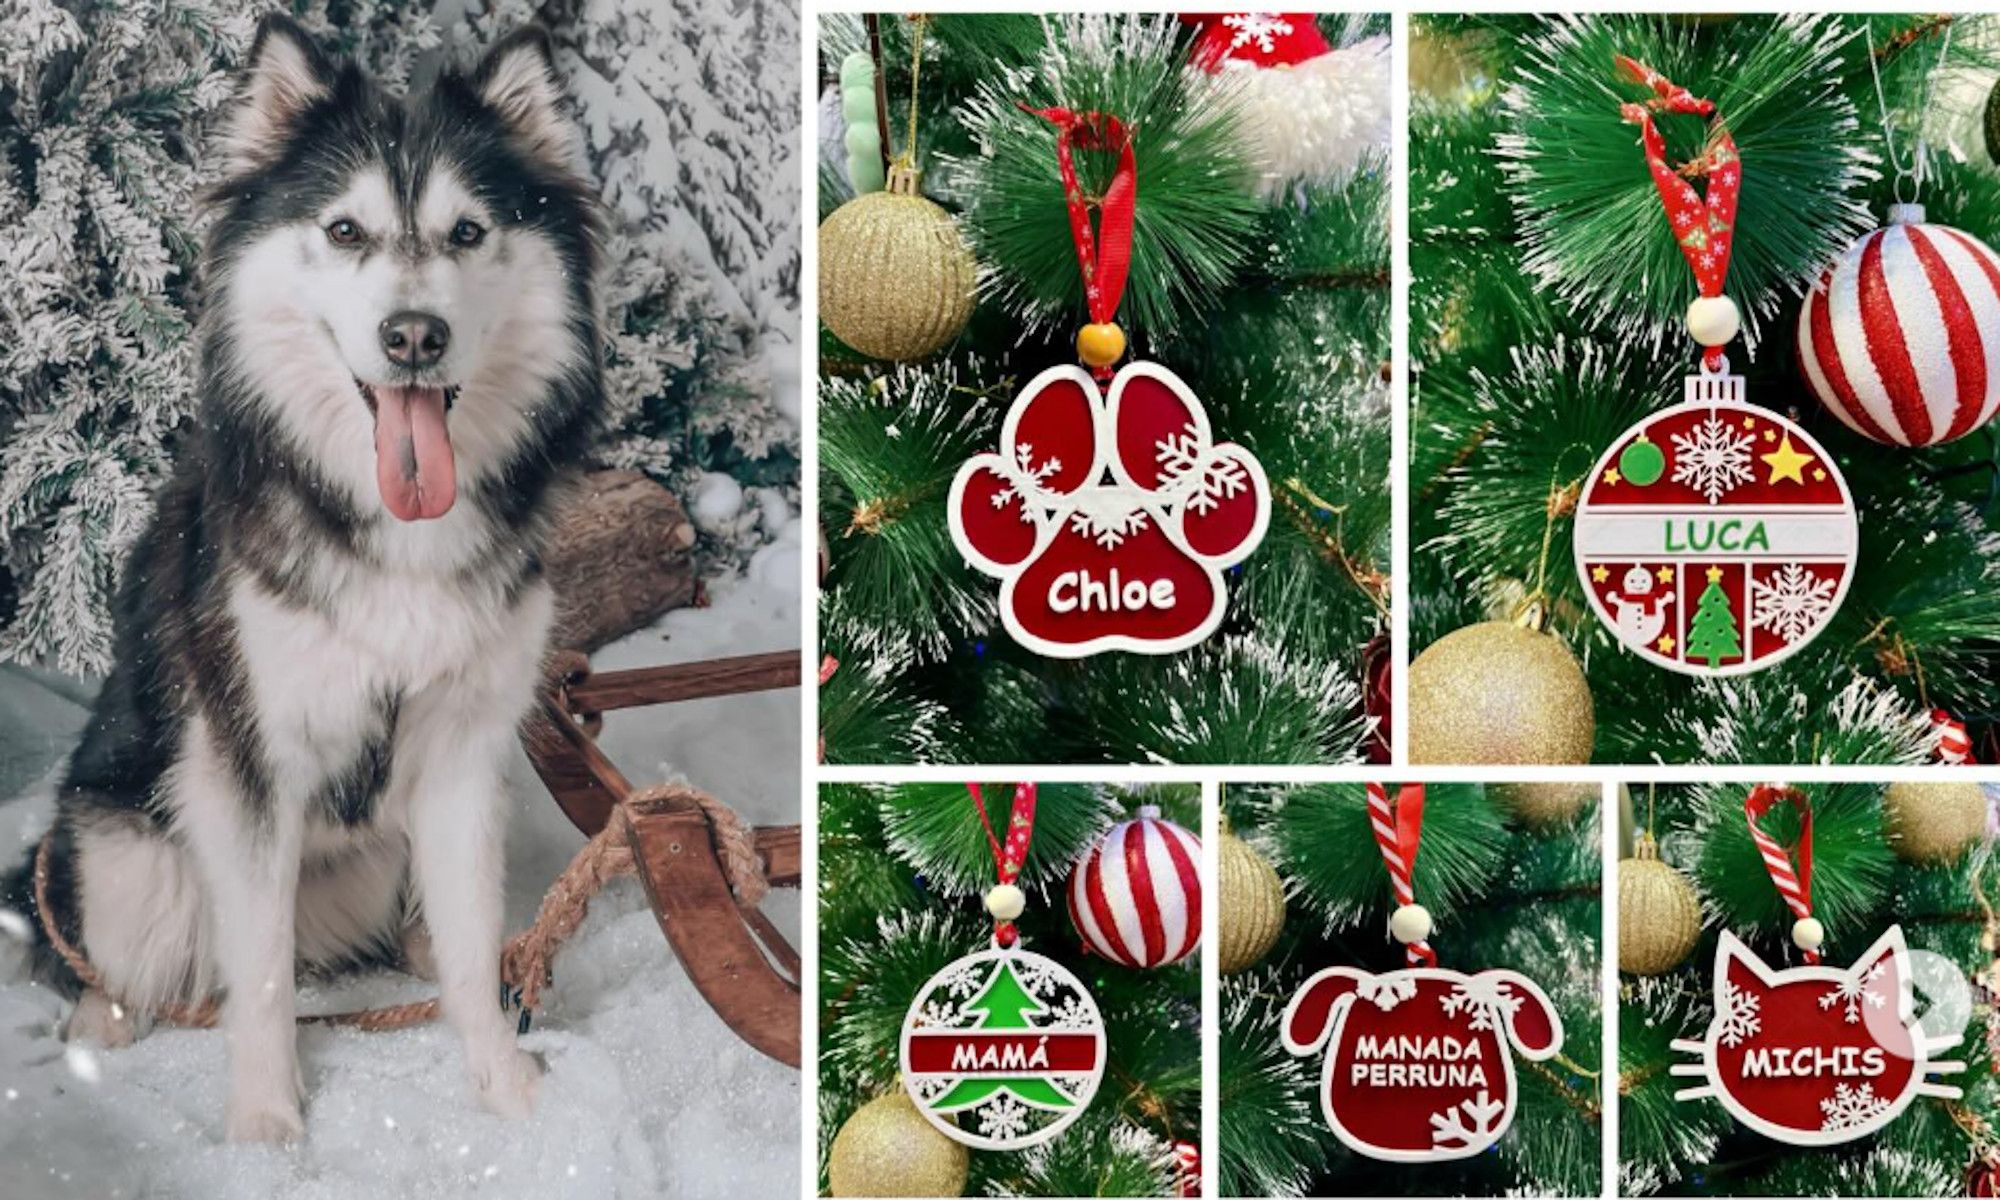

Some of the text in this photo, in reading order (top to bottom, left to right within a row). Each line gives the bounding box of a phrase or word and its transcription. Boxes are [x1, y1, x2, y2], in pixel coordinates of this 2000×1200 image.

[1663, 519, 1770, 553] LUCA
[1047, 567, 1177, 613] Chloe
[950, 1035, 1050, 1070] MAMÁ
[1354, 1035, 1483, 1061] MANADA
[1742, 1046, 1886, 1078] MICHIS
[1350, 1063, 1488, 1087] PERRUNA
